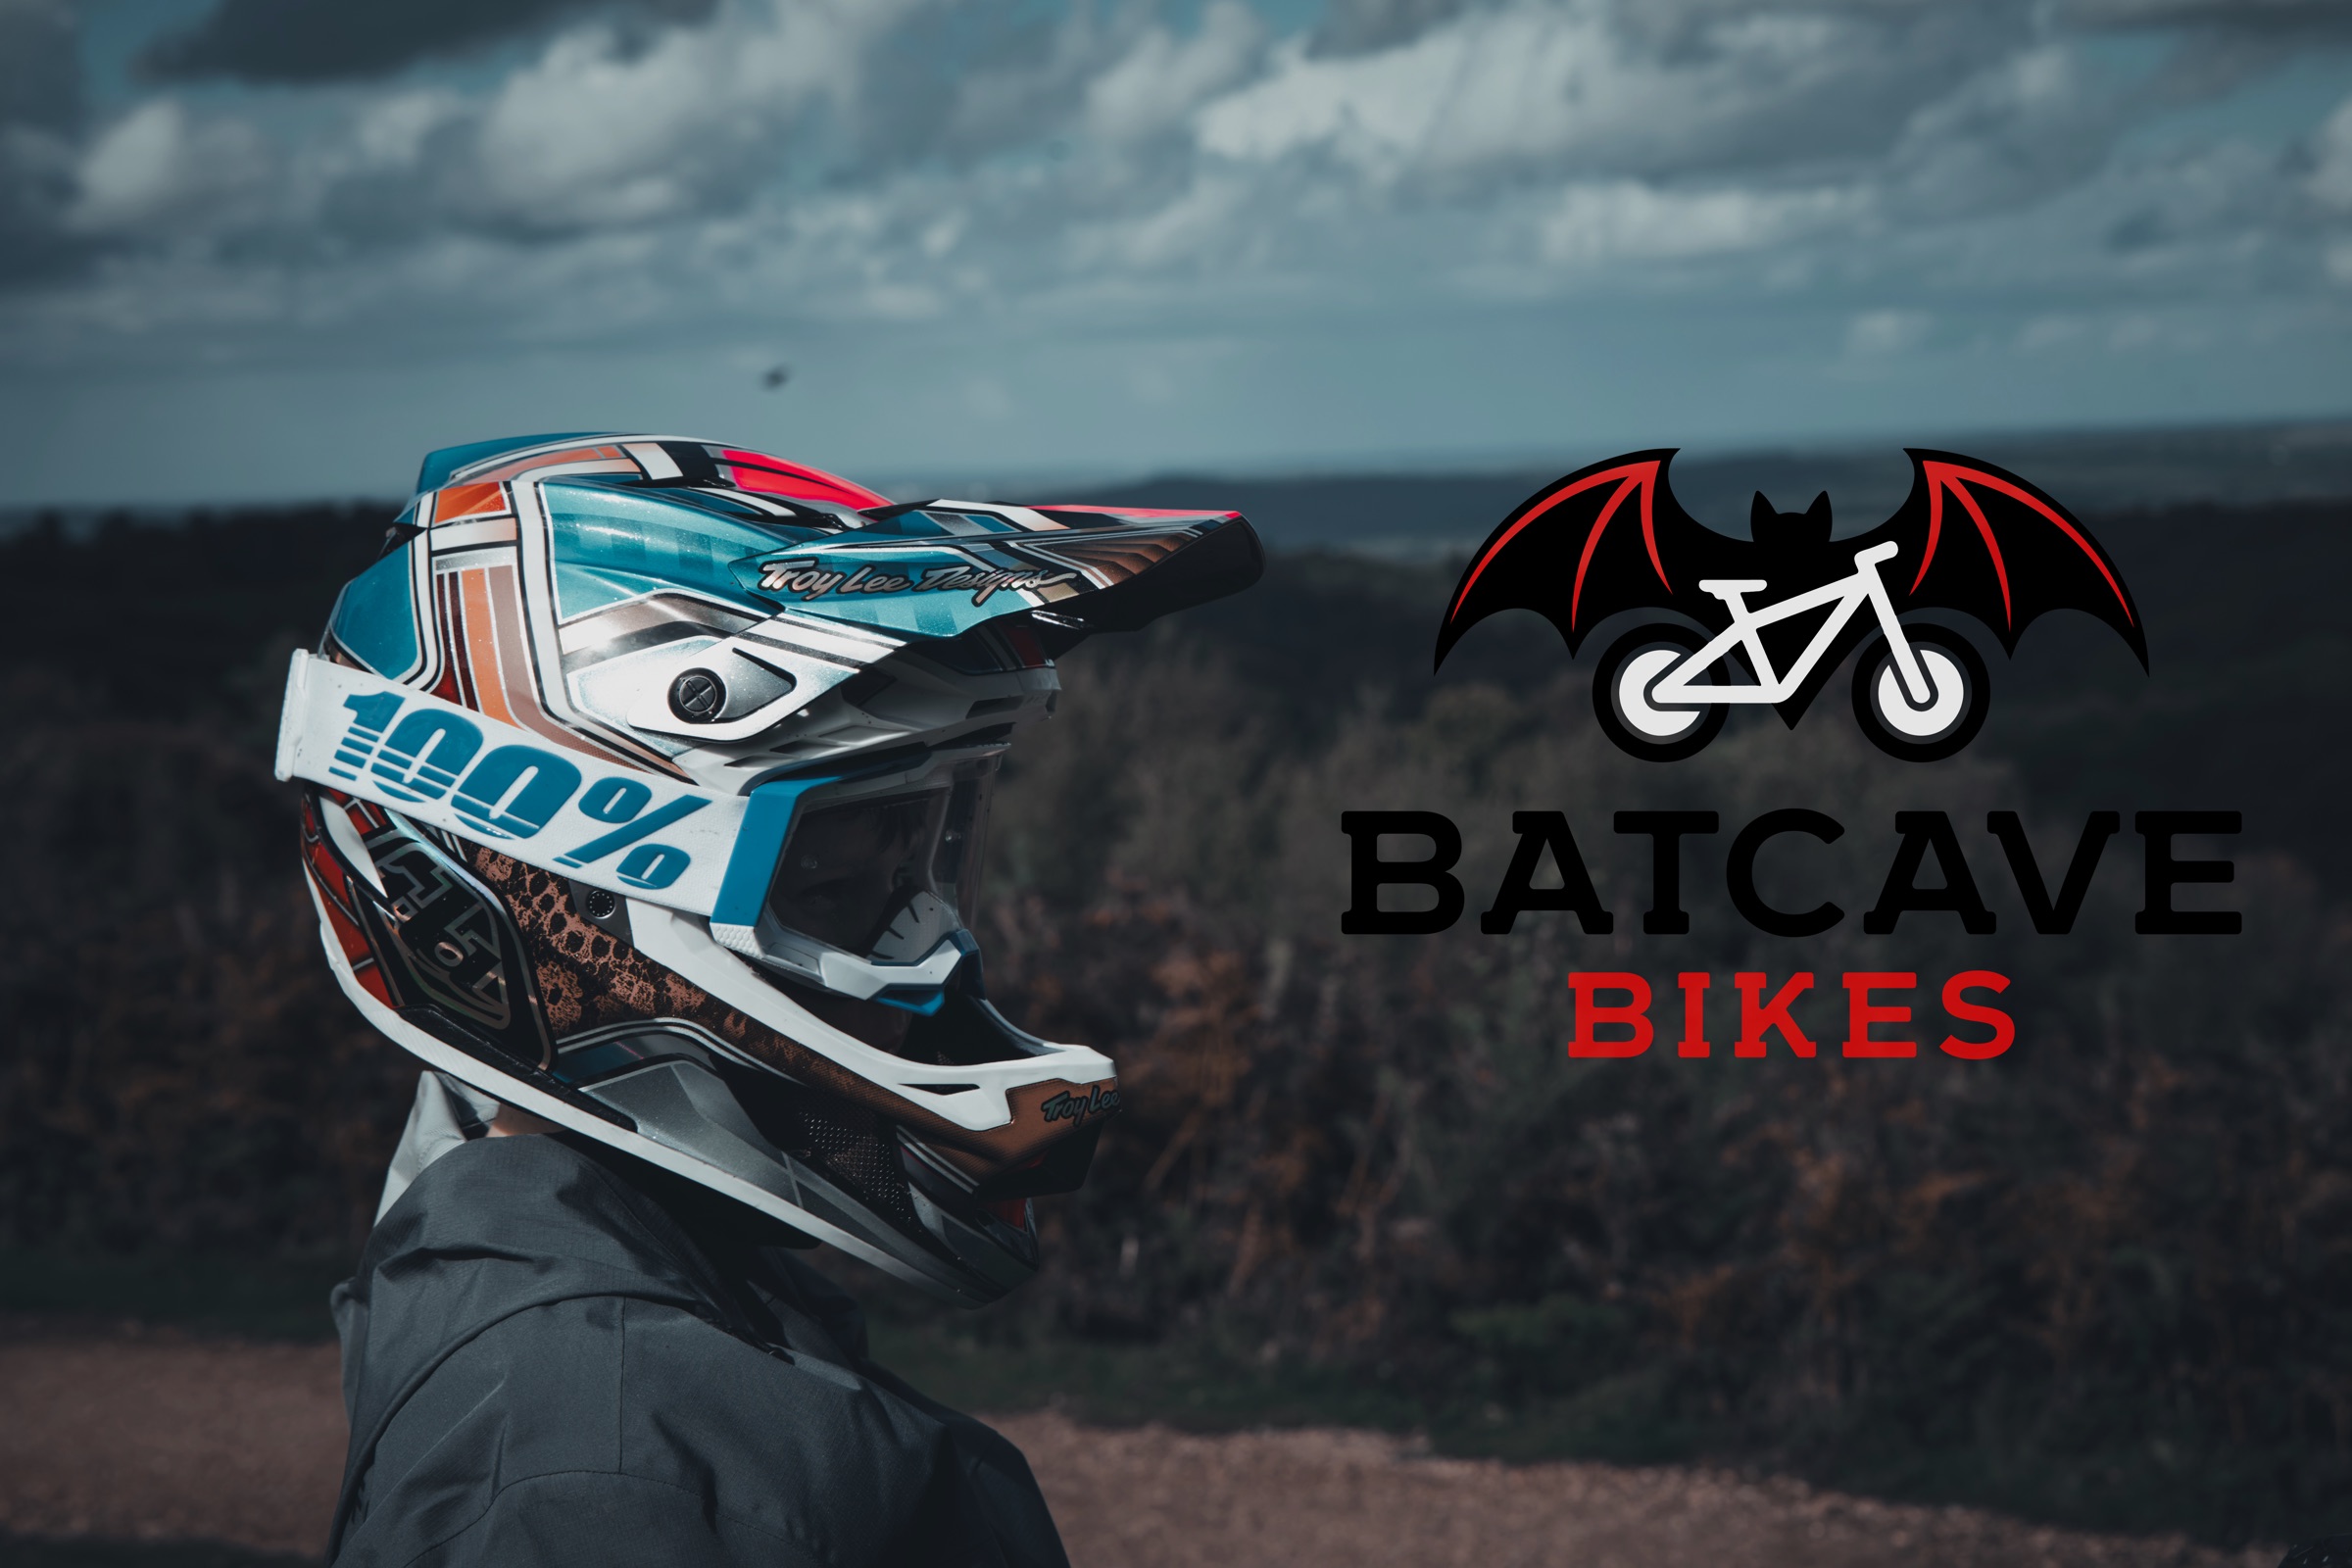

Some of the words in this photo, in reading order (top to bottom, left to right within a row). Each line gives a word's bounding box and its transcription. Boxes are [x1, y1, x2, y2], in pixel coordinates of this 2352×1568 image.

[758, 557, 847, 602] Troy
[837, 564, 913, 594] Lee
[911, 564, 1078, 607] Designs
[328, 691, 711, 890] 100%
[1041, 1090, 1089, 1126] Troy
[1088, 1085, 1120, 1113] Lee
